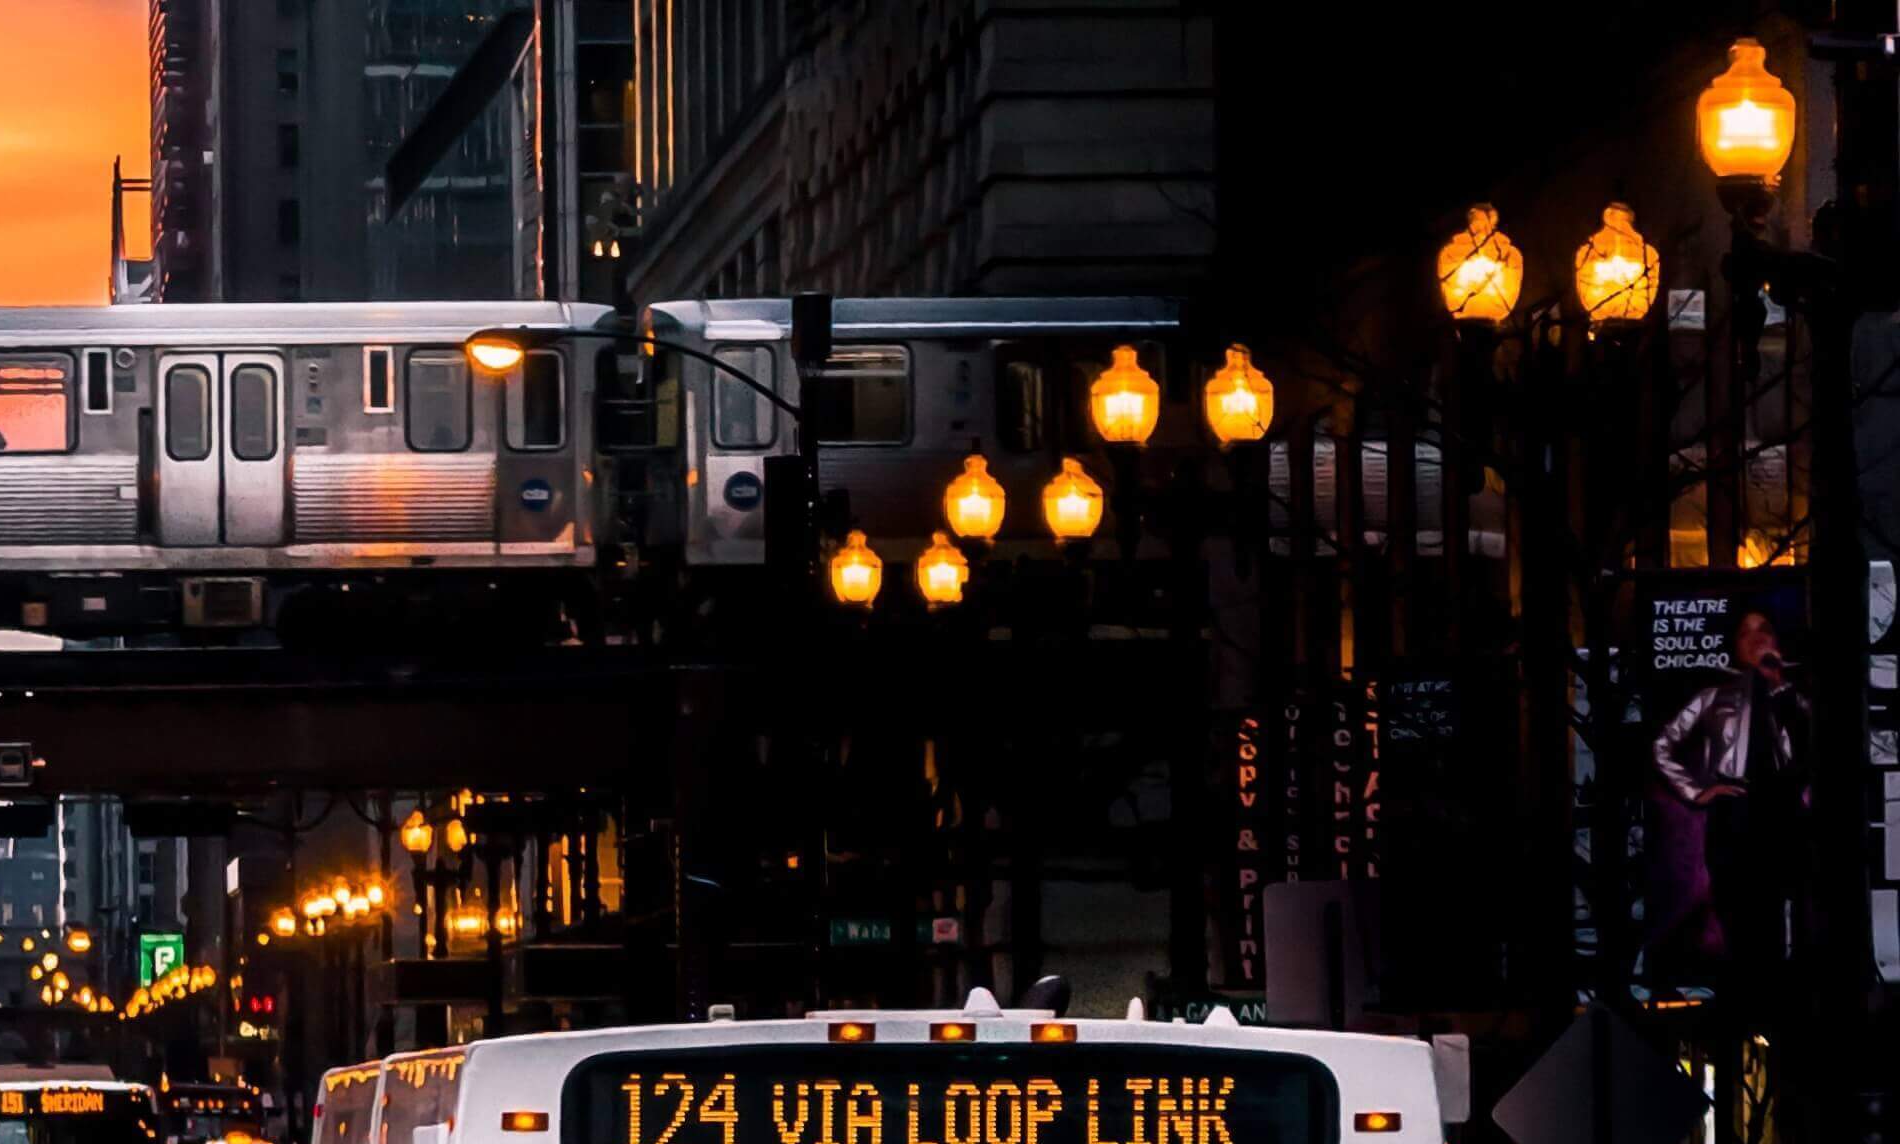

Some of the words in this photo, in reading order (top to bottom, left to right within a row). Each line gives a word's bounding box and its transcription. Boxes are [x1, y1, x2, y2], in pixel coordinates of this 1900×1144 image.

[1653, 600, 1728, 615] THEATRE
[1653, 619, 1669, 633] IS
[1673, 618, 1706, 632] THE
[1653, 637, 1698, 651] SOUL
[1701, 635, 1724, 650] OF
[1654, 653, 1730, 669] CHICAGO
[1237, 828, 1260, 853] &
